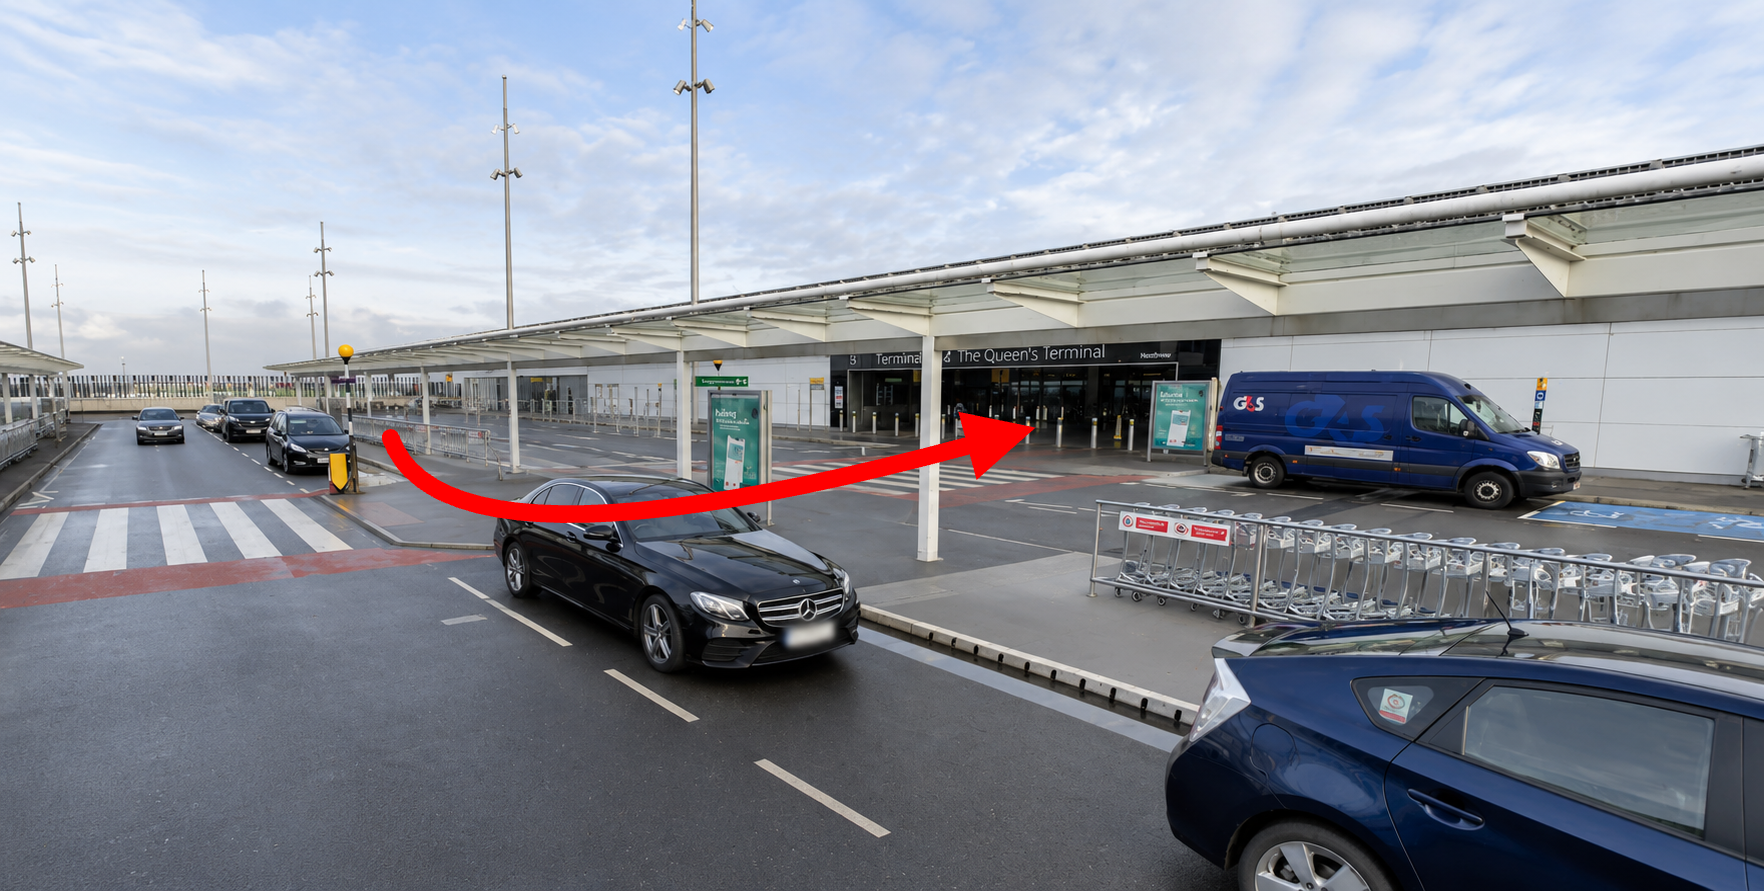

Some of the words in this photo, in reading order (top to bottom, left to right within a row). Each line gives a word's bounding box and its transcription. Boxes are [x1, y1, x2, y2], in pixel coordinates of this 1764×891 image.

[957, 349, 981, 363] The
[984, 347, 1039, 364] Queen's
[1043, 344, 1106, 360] Terminal
